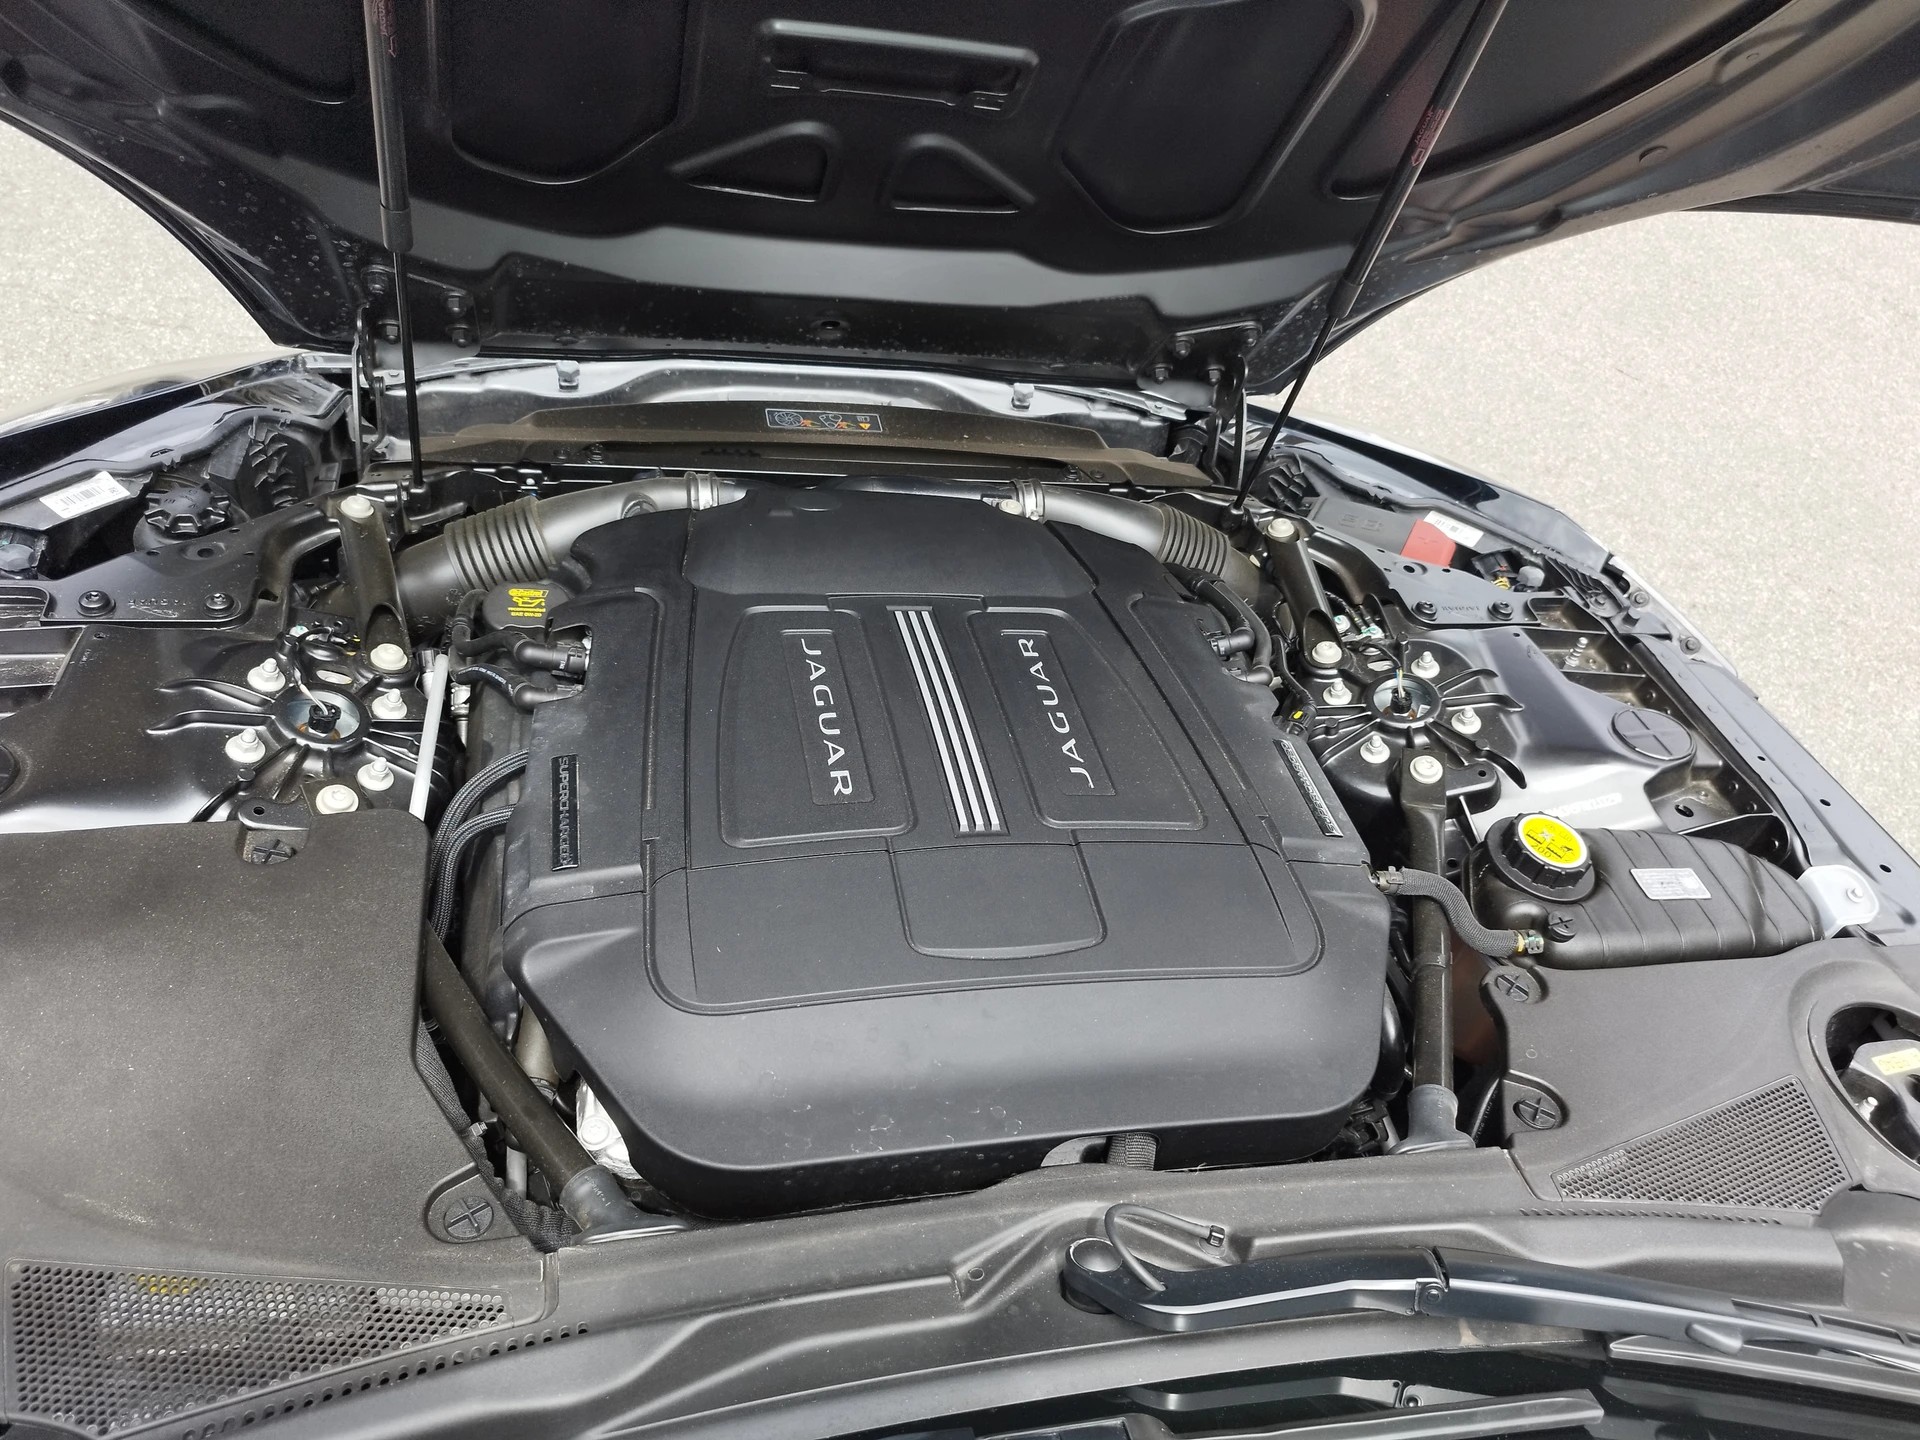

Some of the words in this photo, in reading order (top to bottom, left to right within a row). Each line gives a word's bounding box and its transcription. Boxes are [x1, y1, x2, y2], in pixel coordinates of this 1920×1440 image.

[1414, 110, 1433, 145] JAGUAR
[800, 638, 853, 796] JAGUAR
[1018, 638, 1095, 789] JAGUAR
[558, 756, 570, 866] SUPERCHARGED
[1280, 741, 1337, 832] SUPERCHARGED
